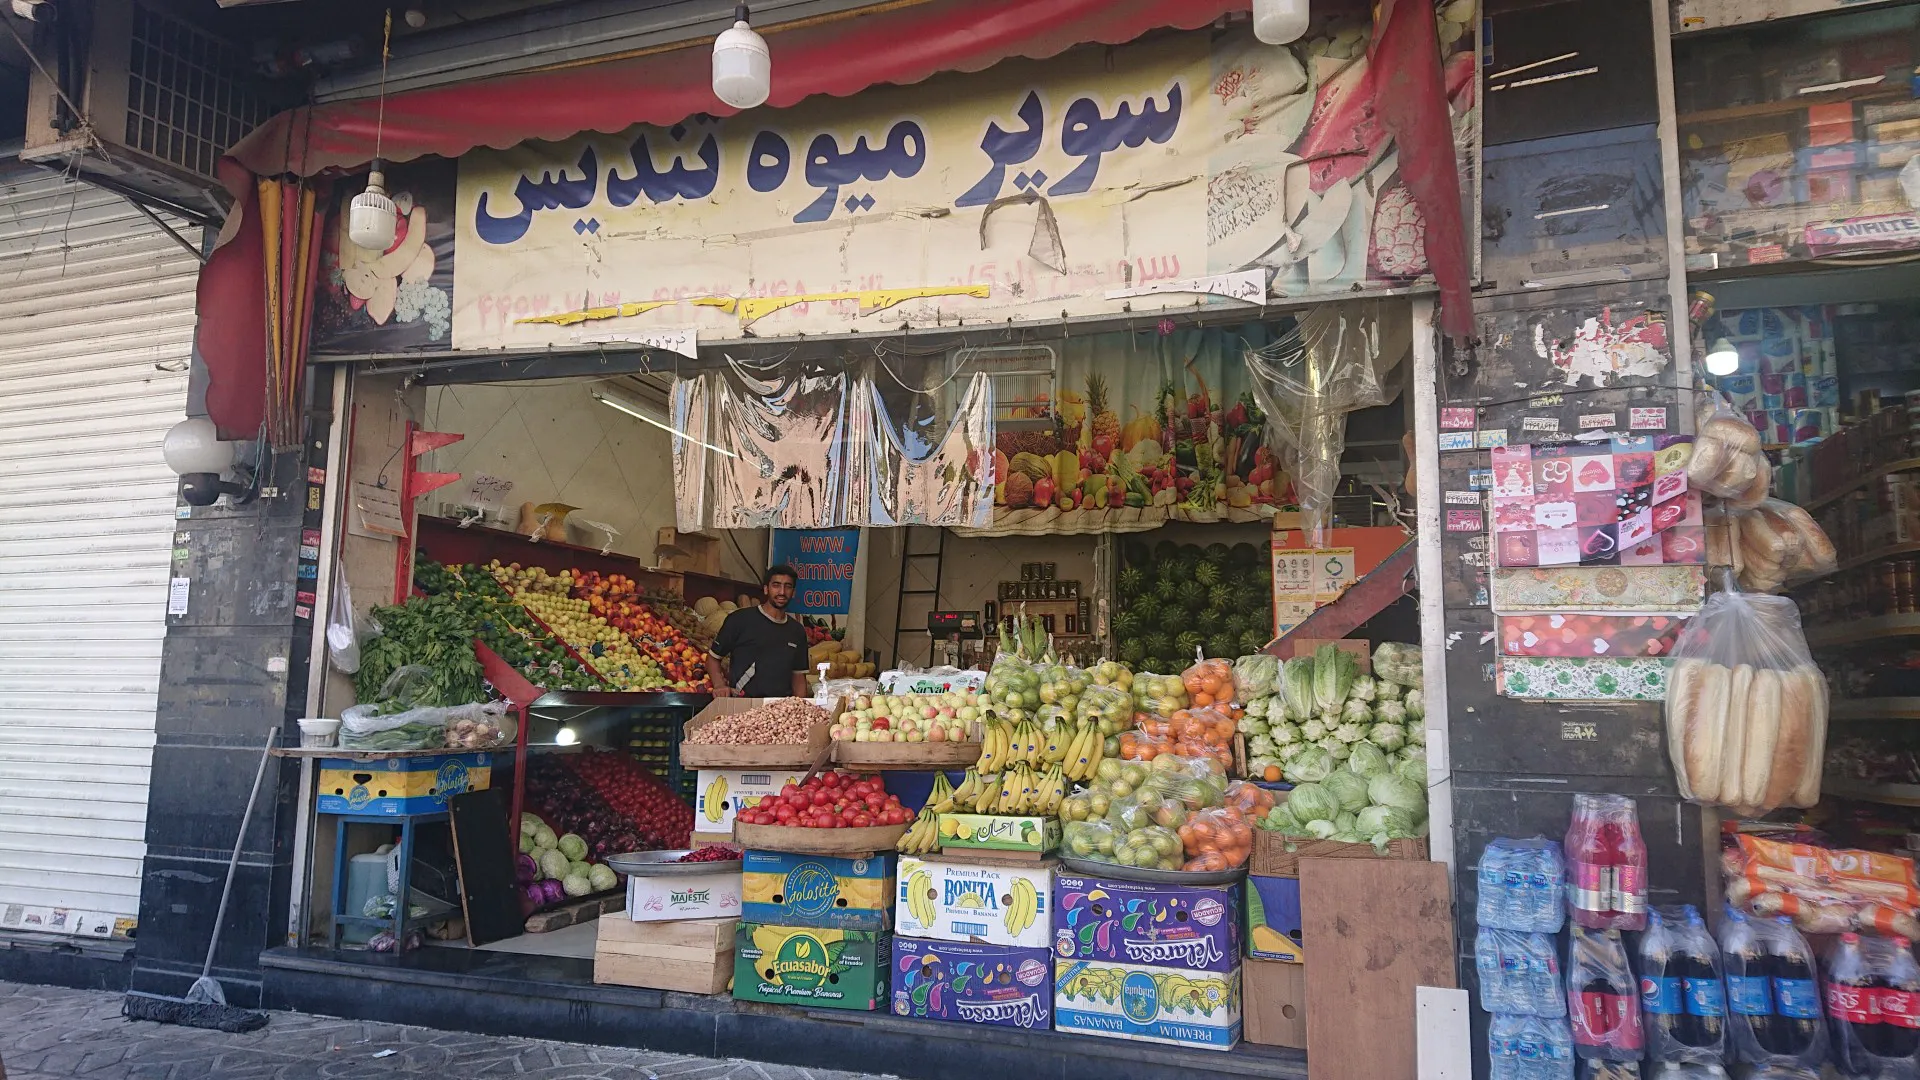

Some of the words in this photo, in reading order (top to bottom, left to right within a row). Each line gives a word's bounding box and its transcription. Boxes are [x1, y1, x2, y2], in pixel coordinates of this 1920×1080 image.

[954, 82, 1182, 208] سوپر
[745, 115, 927, 225] میوه
[474, 112, 722, 245] تندیس
[909, 683, 950, 694] Narvan
[977, 818, 1015, 843] احسان
[946, 868, 979, 878] PREMIUM
[981, 871, 1001, 880] PACK
[671, 892, 710, 904] MAJESTIC
[944, 879, 999, 910] BONITA
[945, 908, 969, 916] PREMIUM
[1192, 905, 1223, 919] ECUADOR
[773, 960, 832, 977] Ecuasabor
[758, 983, 782, 994] Tropical
[785, 985, 812, 996] Premium
[814, 987, 844, 998] Bananas
[1124, 984, 1155, 1000] Chiquita
[1073, 1014, 1123, 1030] BANANAS
[1159, 1025, 1212, 1041] PREMIUM
